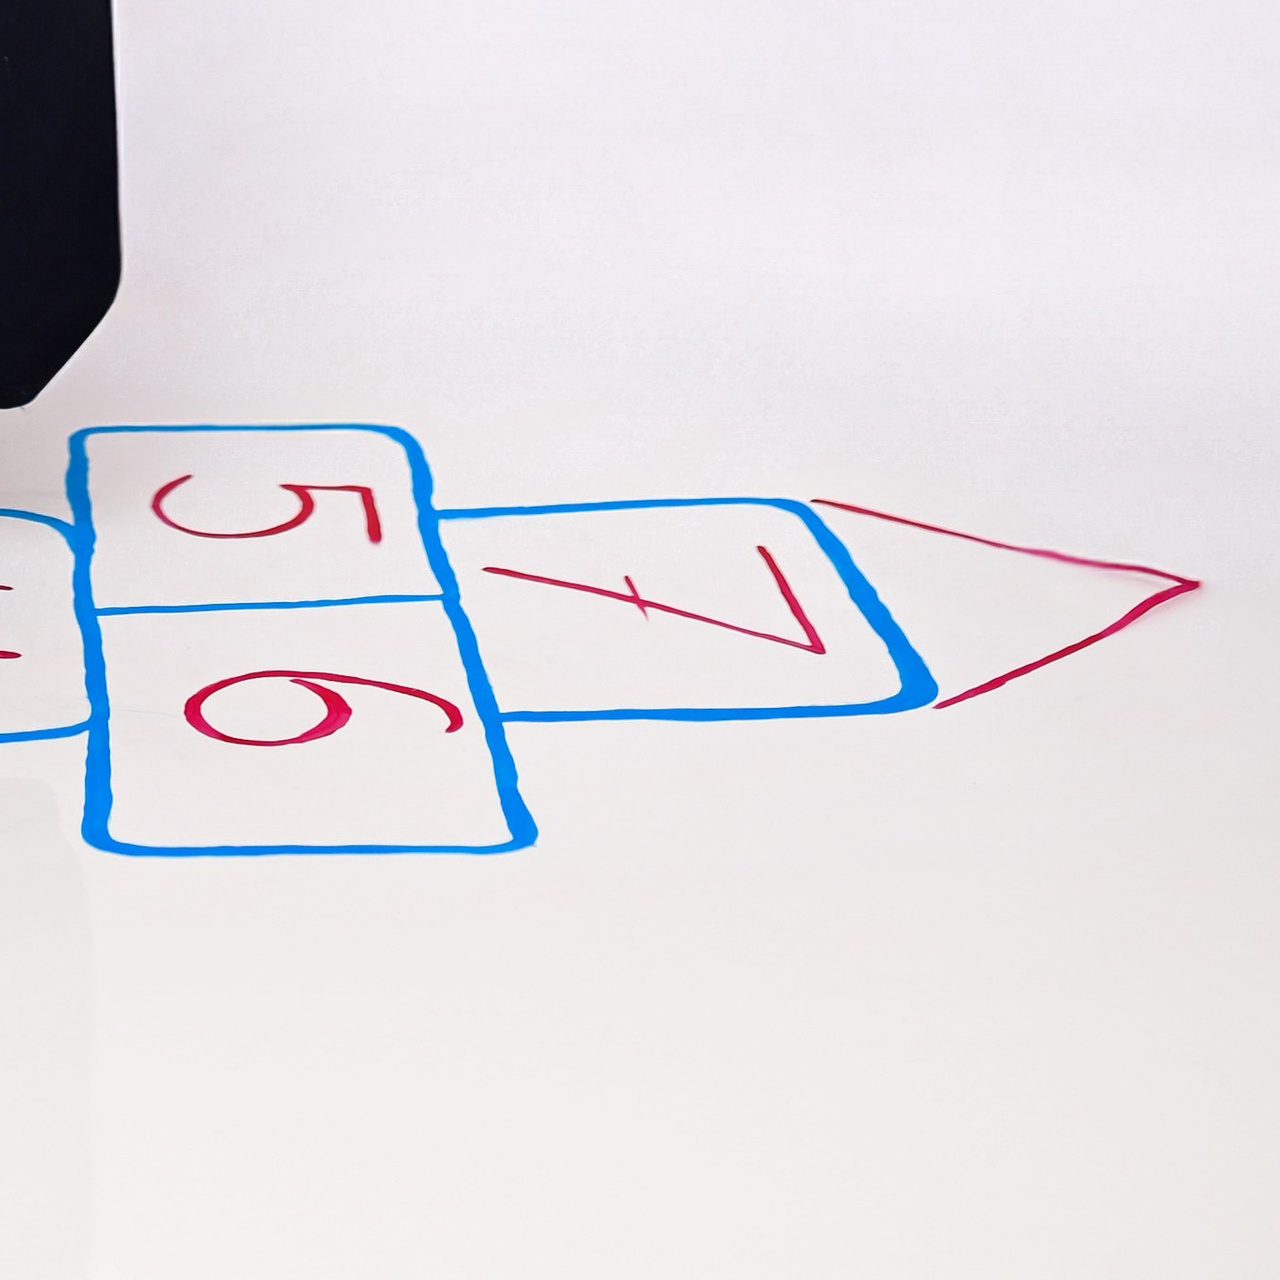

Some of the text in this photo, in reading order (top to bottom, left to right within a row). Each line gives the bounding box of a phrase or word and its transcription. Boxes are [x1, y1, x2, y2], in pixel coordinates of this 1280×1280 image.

[150, 474, 383, 545] 5
[482, 544, 827, 655] 7
[183, 669, 465, 747] 6
